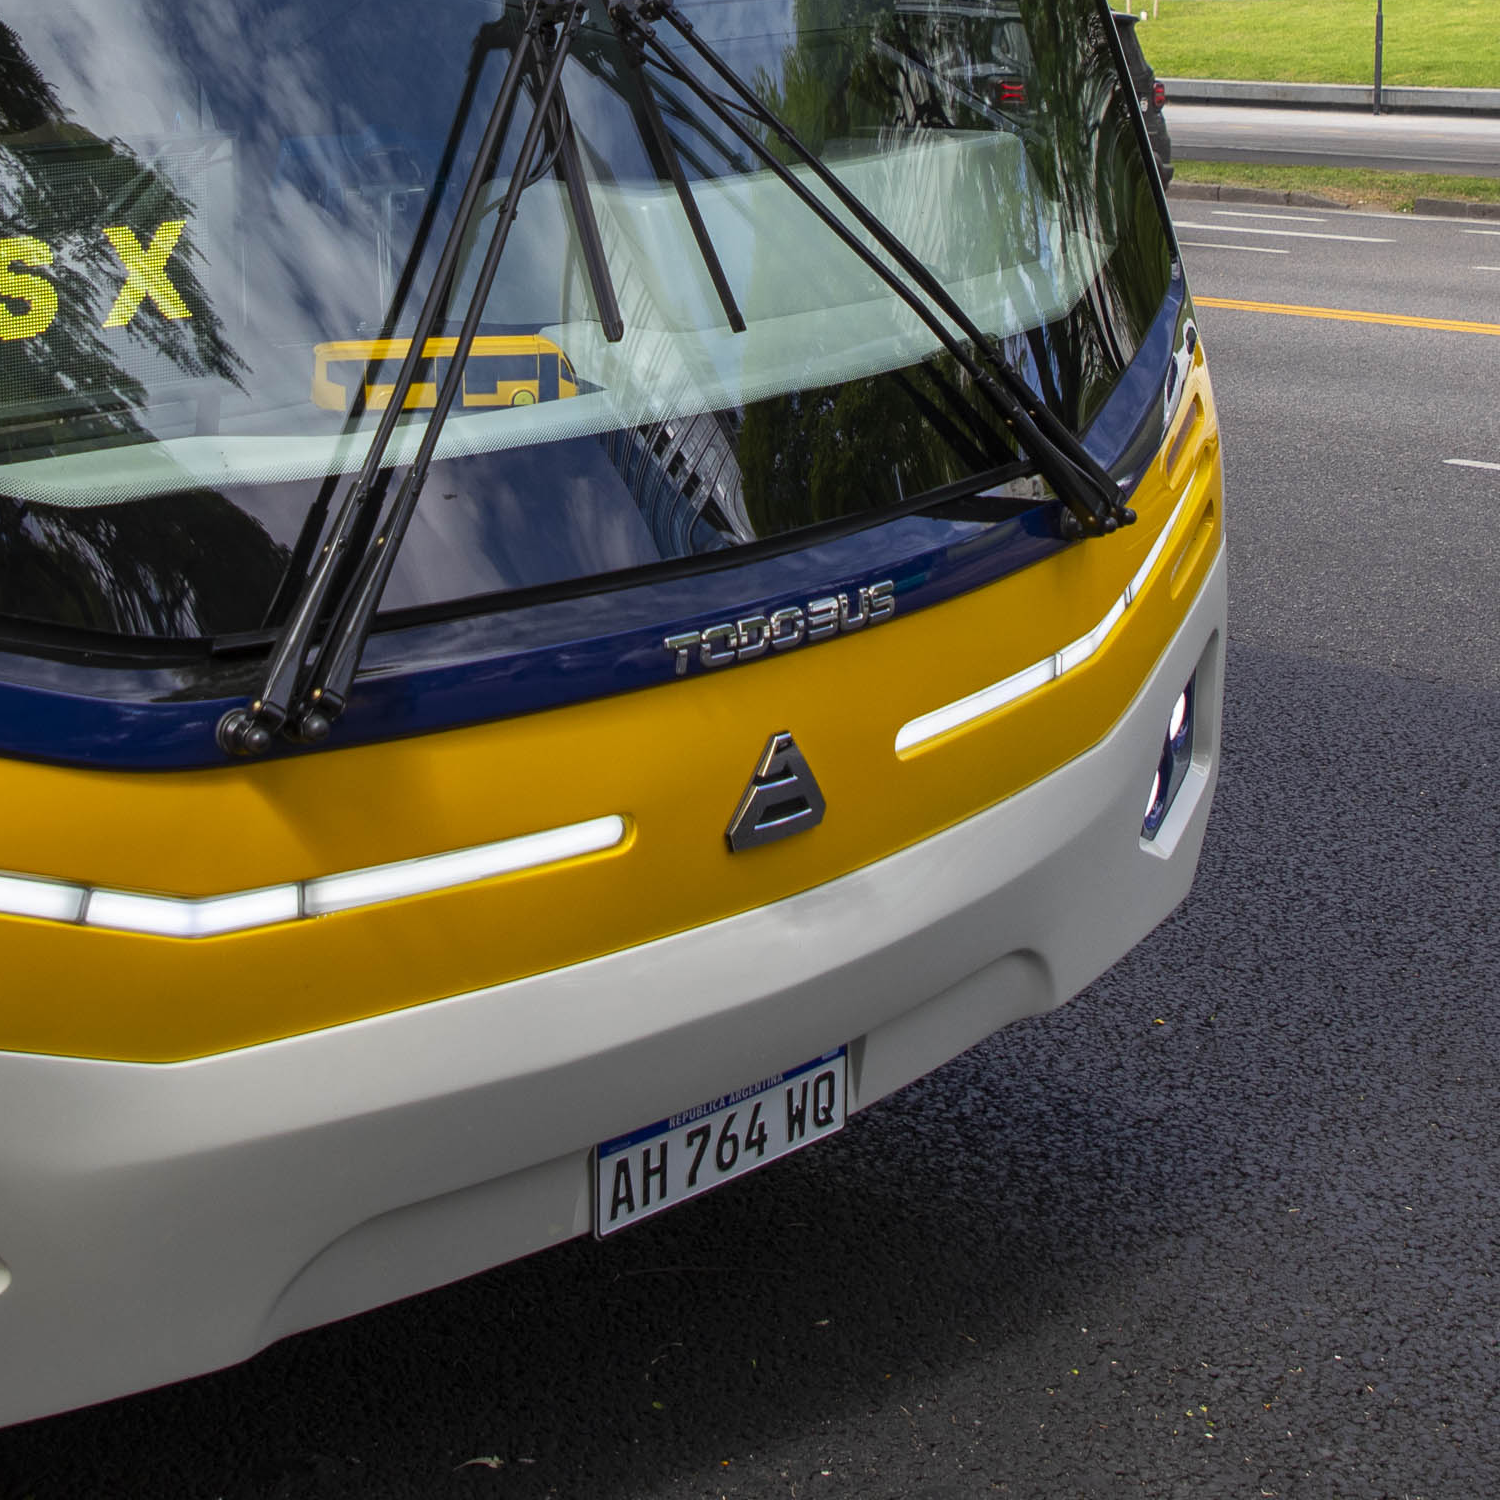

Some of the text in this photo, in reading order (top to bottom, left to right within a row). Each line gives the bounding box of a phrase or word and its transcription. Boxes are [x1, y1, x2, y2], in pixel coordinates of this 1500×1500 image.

[102, 220, 193, 328] X
[664, 580, 895, 676] TODOBUS
[610, 1070, 835, 1221] AH 764 WQ
